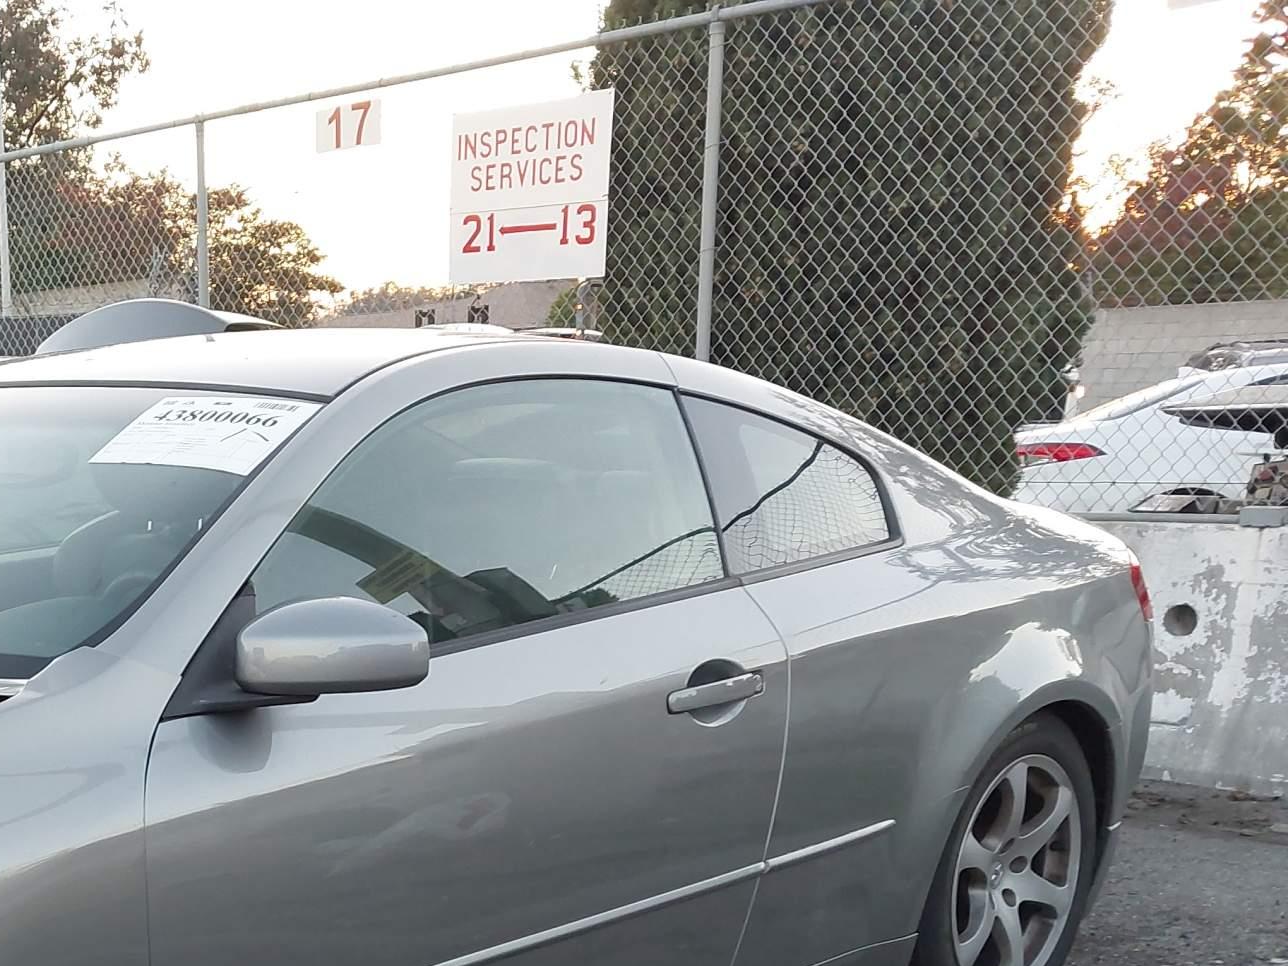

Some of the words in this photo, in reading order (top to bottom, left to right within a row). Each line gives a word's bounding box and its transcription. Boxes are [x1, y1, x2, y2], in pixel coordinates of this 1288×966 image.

[327, 100, 372, 149] 17
[457, 116, 597, 161] INSPECTION
[470, 153, 584, 192] SERVICES
[461, 212, 497, 254] 21
[559, 203, 598, 246] 13
[153, 408, 280, 428] 43800066
